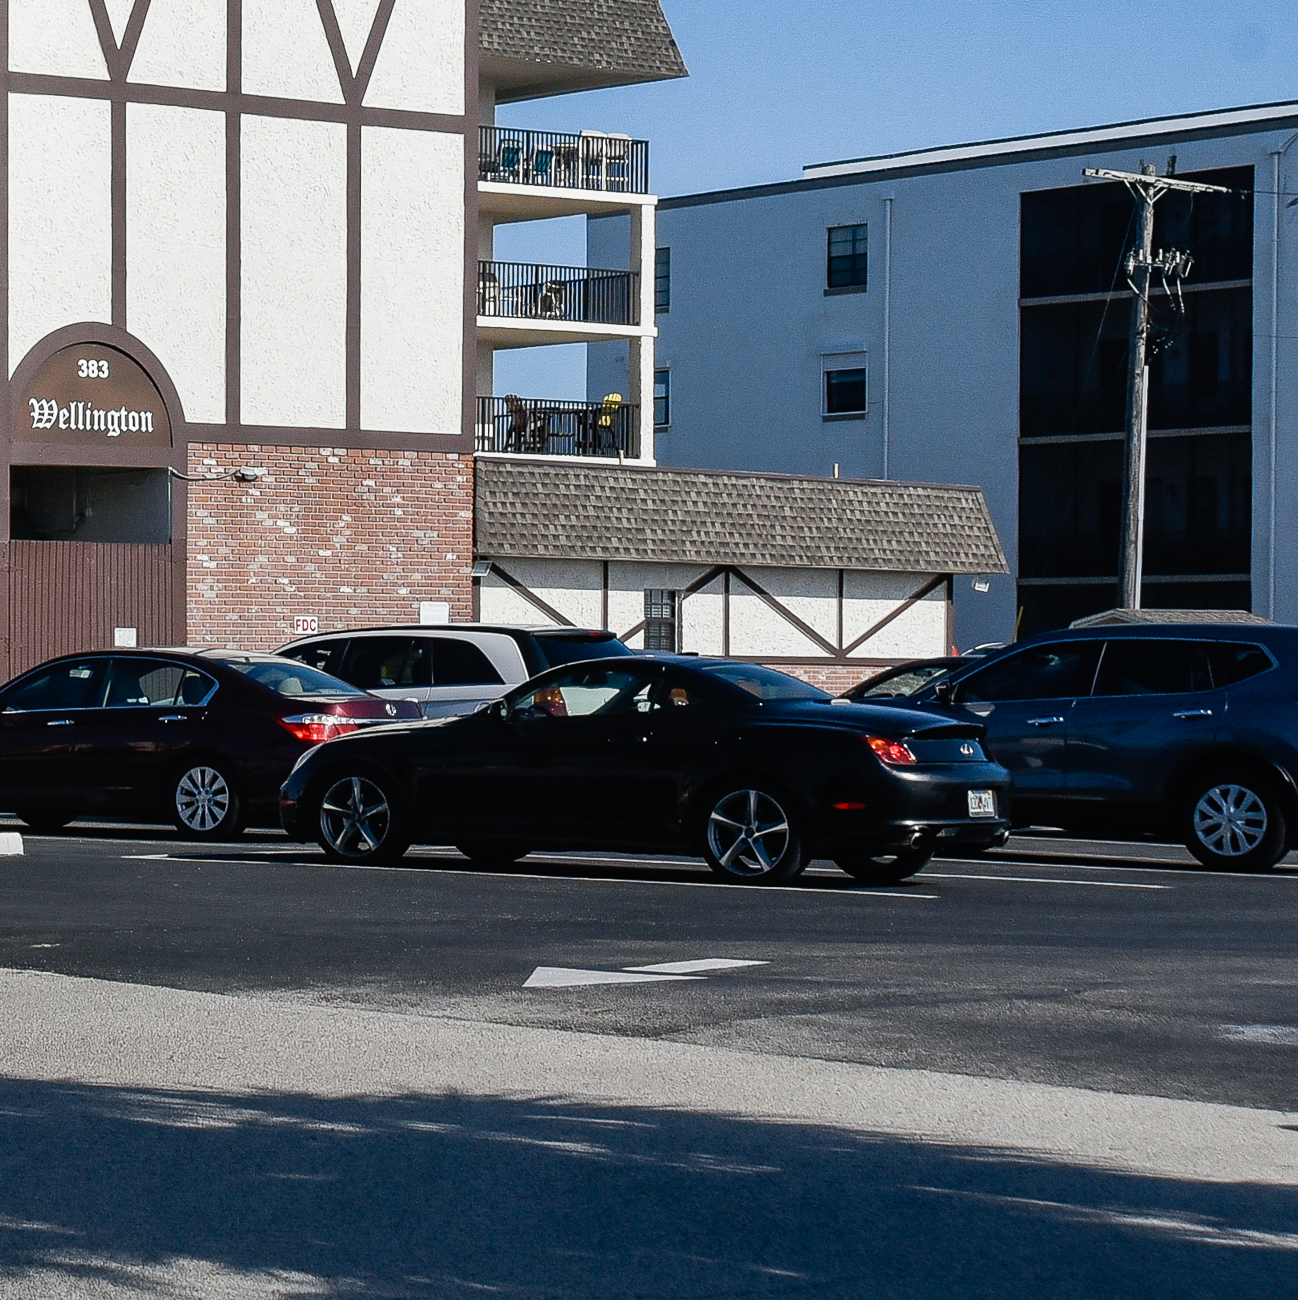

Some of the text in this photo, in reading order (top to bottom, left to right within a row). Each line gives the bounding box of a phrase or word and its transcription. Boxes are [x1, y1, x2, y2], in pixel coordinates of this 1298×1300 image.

[78, 359, 110, 379] 383
[29, 397, 154, 437] Wellington
[295, 618, 317, 632] FDC
